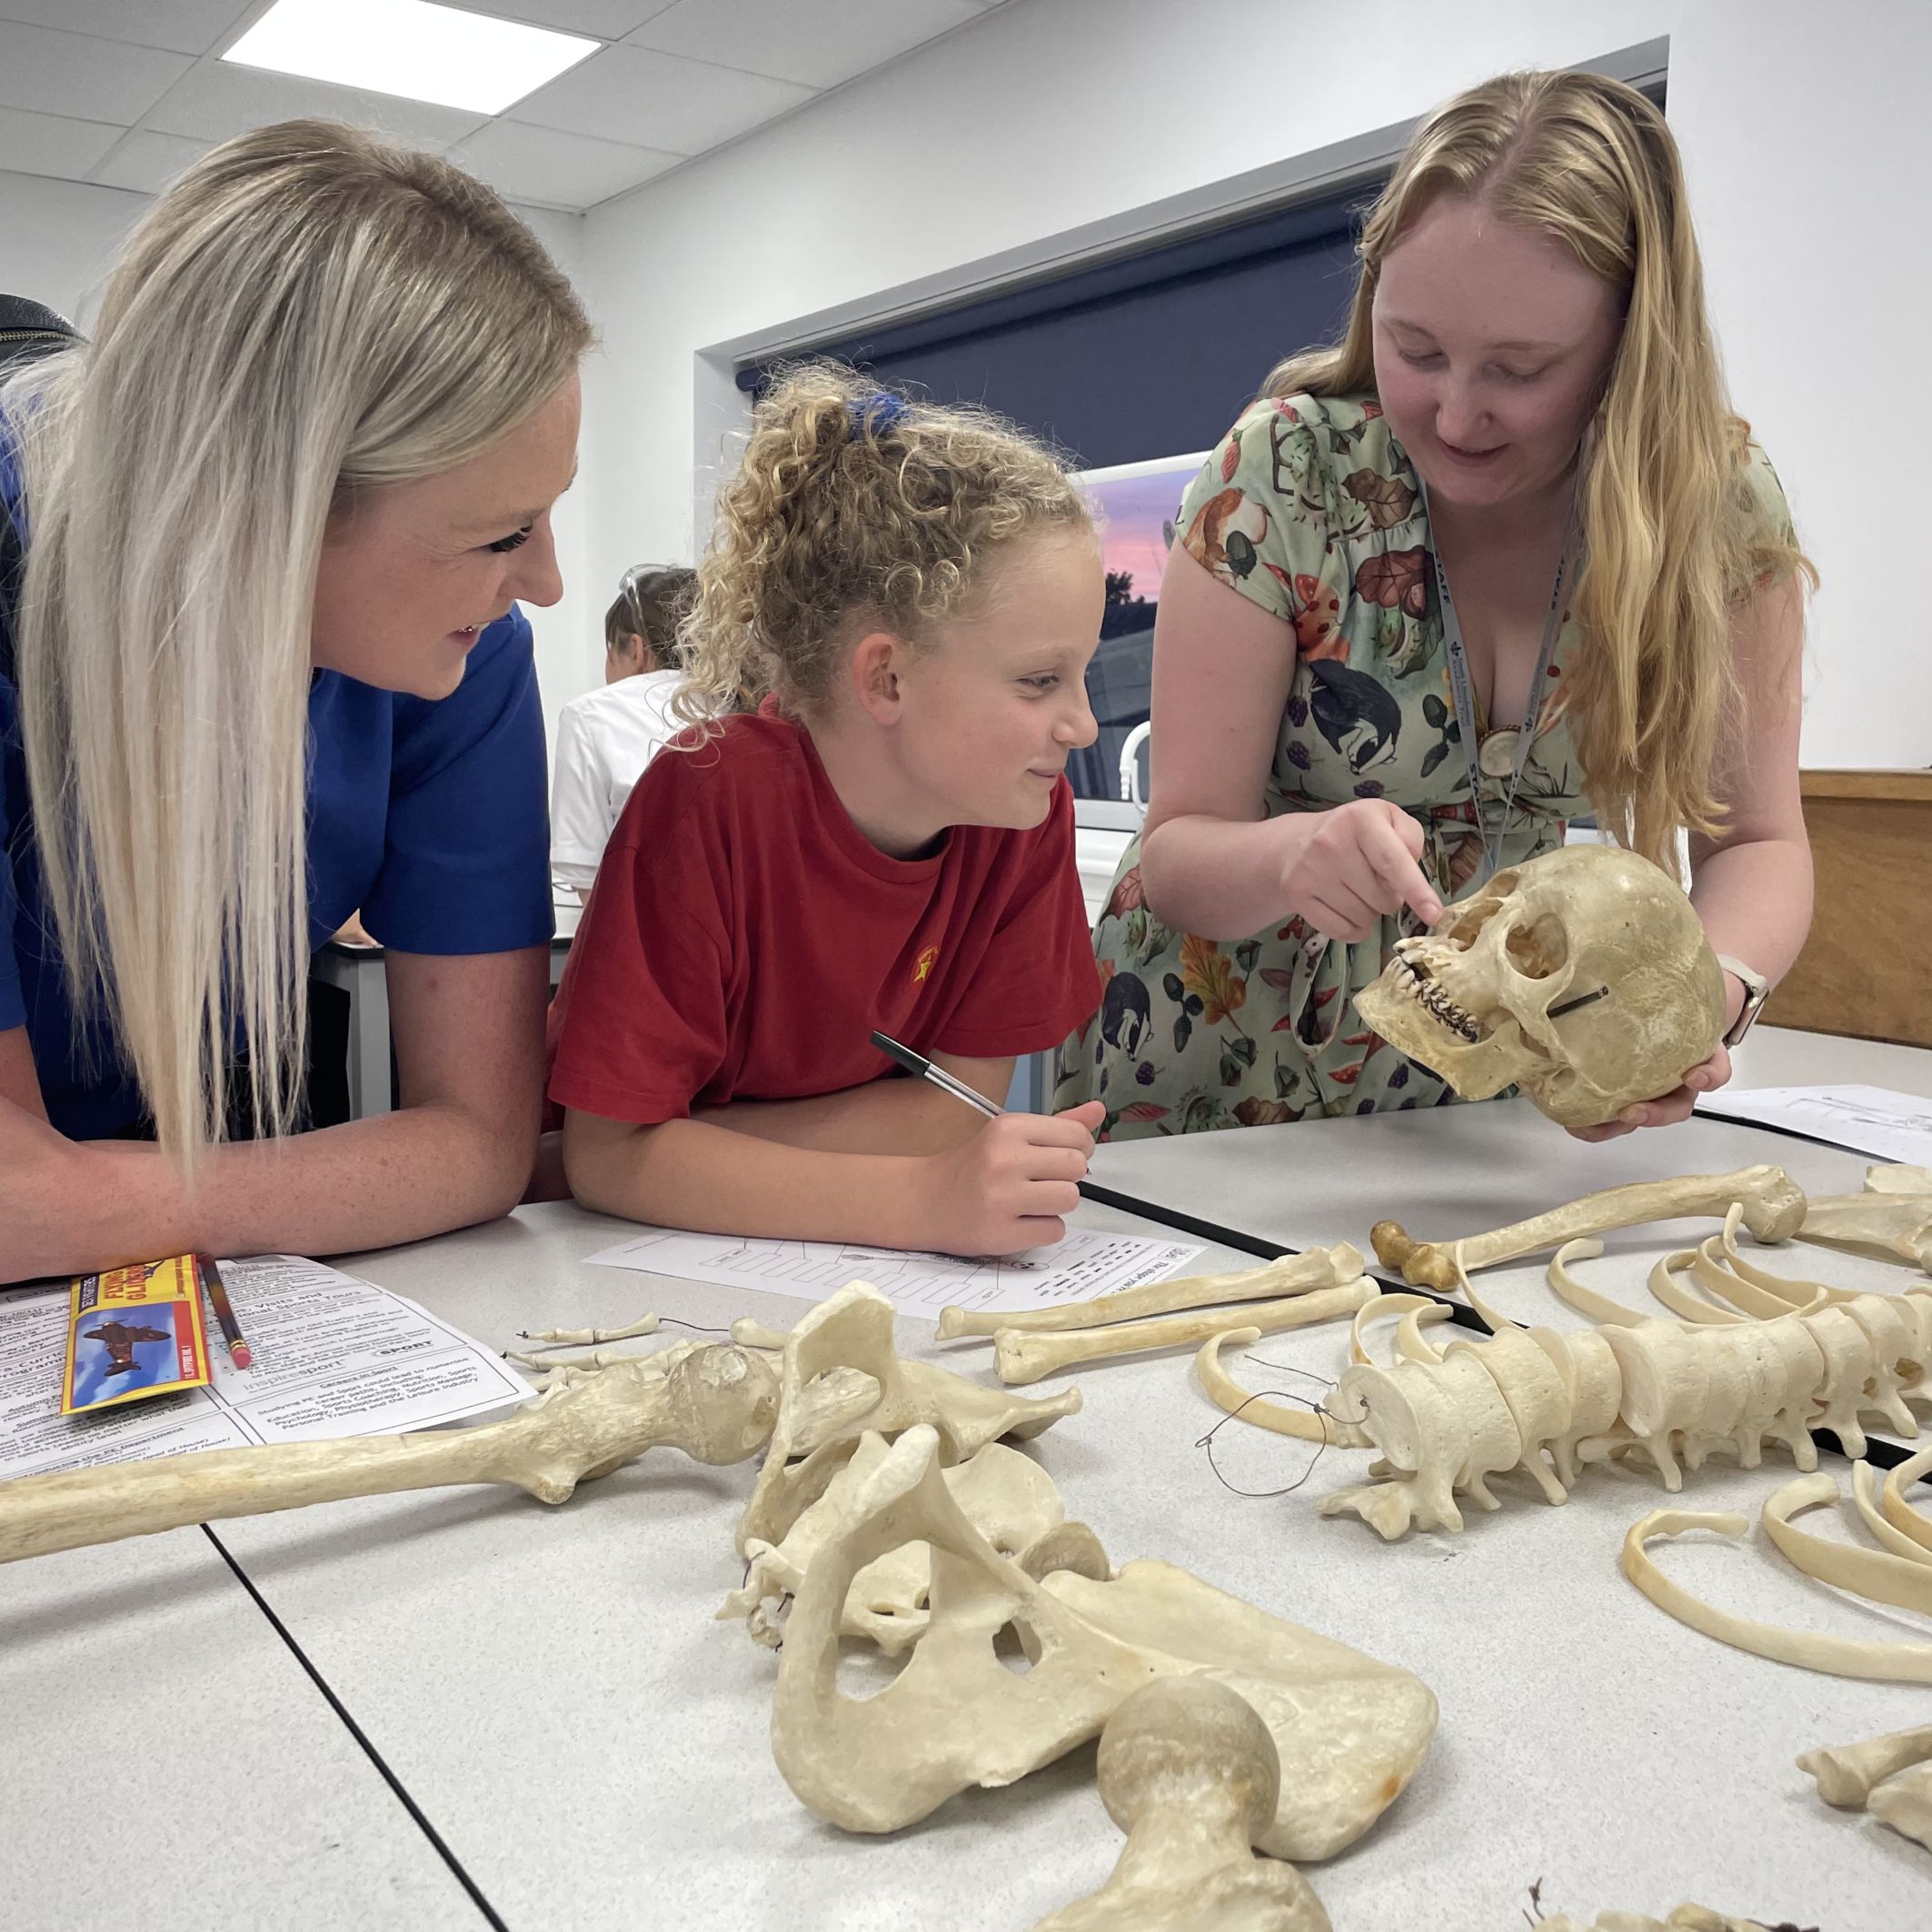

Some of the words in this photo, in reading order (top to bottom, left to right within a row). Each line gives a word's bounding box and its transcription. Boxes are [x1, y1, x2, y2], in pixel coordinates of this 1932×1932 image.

[103, 1270, 124, 1300] FLYING
[125, 1265, 146, 1300] GLIDERS
[254, 1297, 293, 1309] Visits
[278, 1298, 320, 1310] Sports
[324, 1290, 361, 1300] Tours
[379, 1339, 432, 1355] SPORT
[257, 1399, 300, 1416] Studying
[317, 1390, 334, 1399] and
[336, 1384, 361, 1395] Sport
[363, 1377, 389, 1387] could
[391, 1370, 411, 1379] lead
[426, 1357, 468, 1370] numerous
[319, 1376, 357, 1389] Careers
[371, 1365, 398, 1376] Sport
[267, 1405, 320, 1423] Education,
[321, 1397, 352, 1409] Sports
[354, 1386, 400, 1401] Coaching,
[402, 1373, 446, 1388] Nutrition,
[447, 1365, 476, 1377] Sports
[274, 1408, 332, 1427] Psychology,
[334, 1390, 404, 1412] Physiotherapy,
[405, 1382, 434, 1393] Sports
[282, 1415, 324, 1430] Personal
[327, 1404, 367, 1420] Training
[369, 1400, 386, 1409] and
[389, 1395, 404, 1404] the
[407, 1385, 440, 1399] Leisure
[442, 1376, 477, 1390] Industry
[314, 1394, 344, 1405] career
[348, 1386, 377, 1398] paths,
[17, 1447, 50, 1459] sports
[53, 1437, 85, 1448] teams
[103, 1420, 137, 1433] matter
[141, 1411, 165, 1421] what
[168, 1402, 191, 1412] their
[45, 1429, 90, 1446] welcome
[107, 1414, 141, 1427] attend
[60, 1438, 94, 1450] ability
[96, 1430, 122, 1440] level
[121, 1427, 184, 1449] Department
